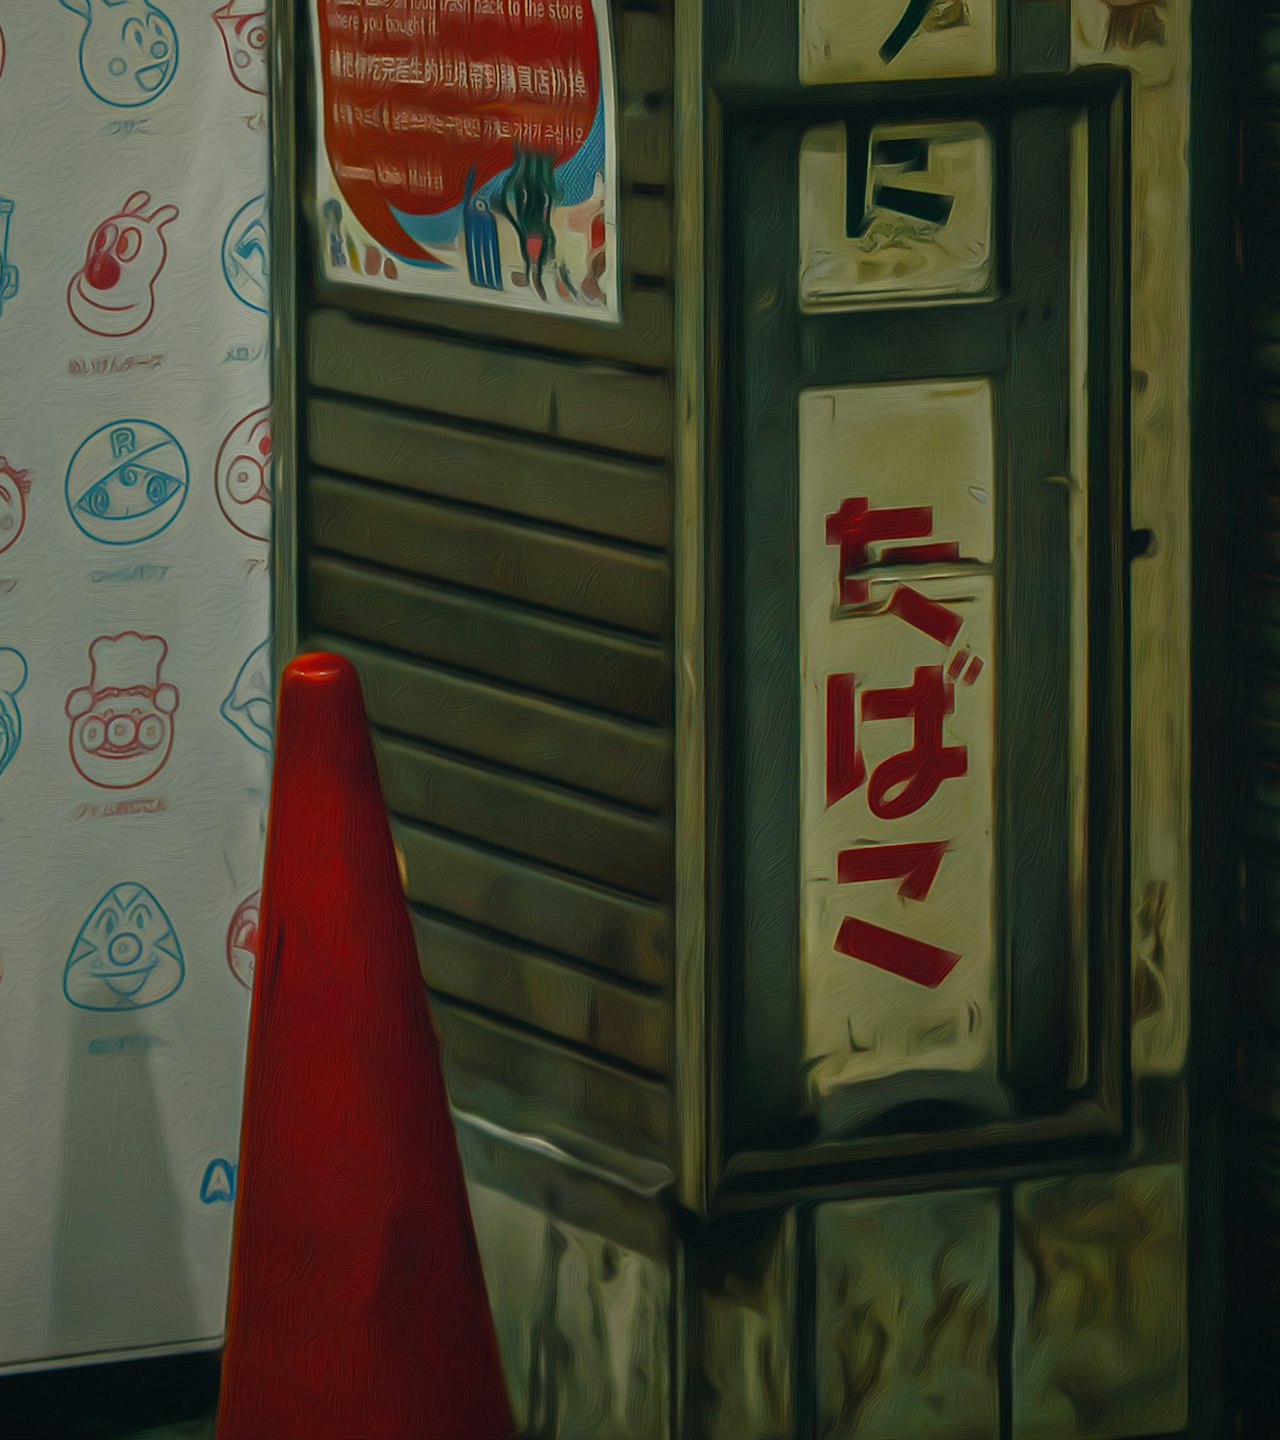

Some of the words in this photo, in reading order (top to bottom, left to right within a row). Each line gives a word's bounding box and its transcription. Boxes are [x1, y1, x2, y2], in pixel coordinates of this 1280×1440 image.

[548, 0, 584, 20] store
[825, 497, 986, 990] たばこ
